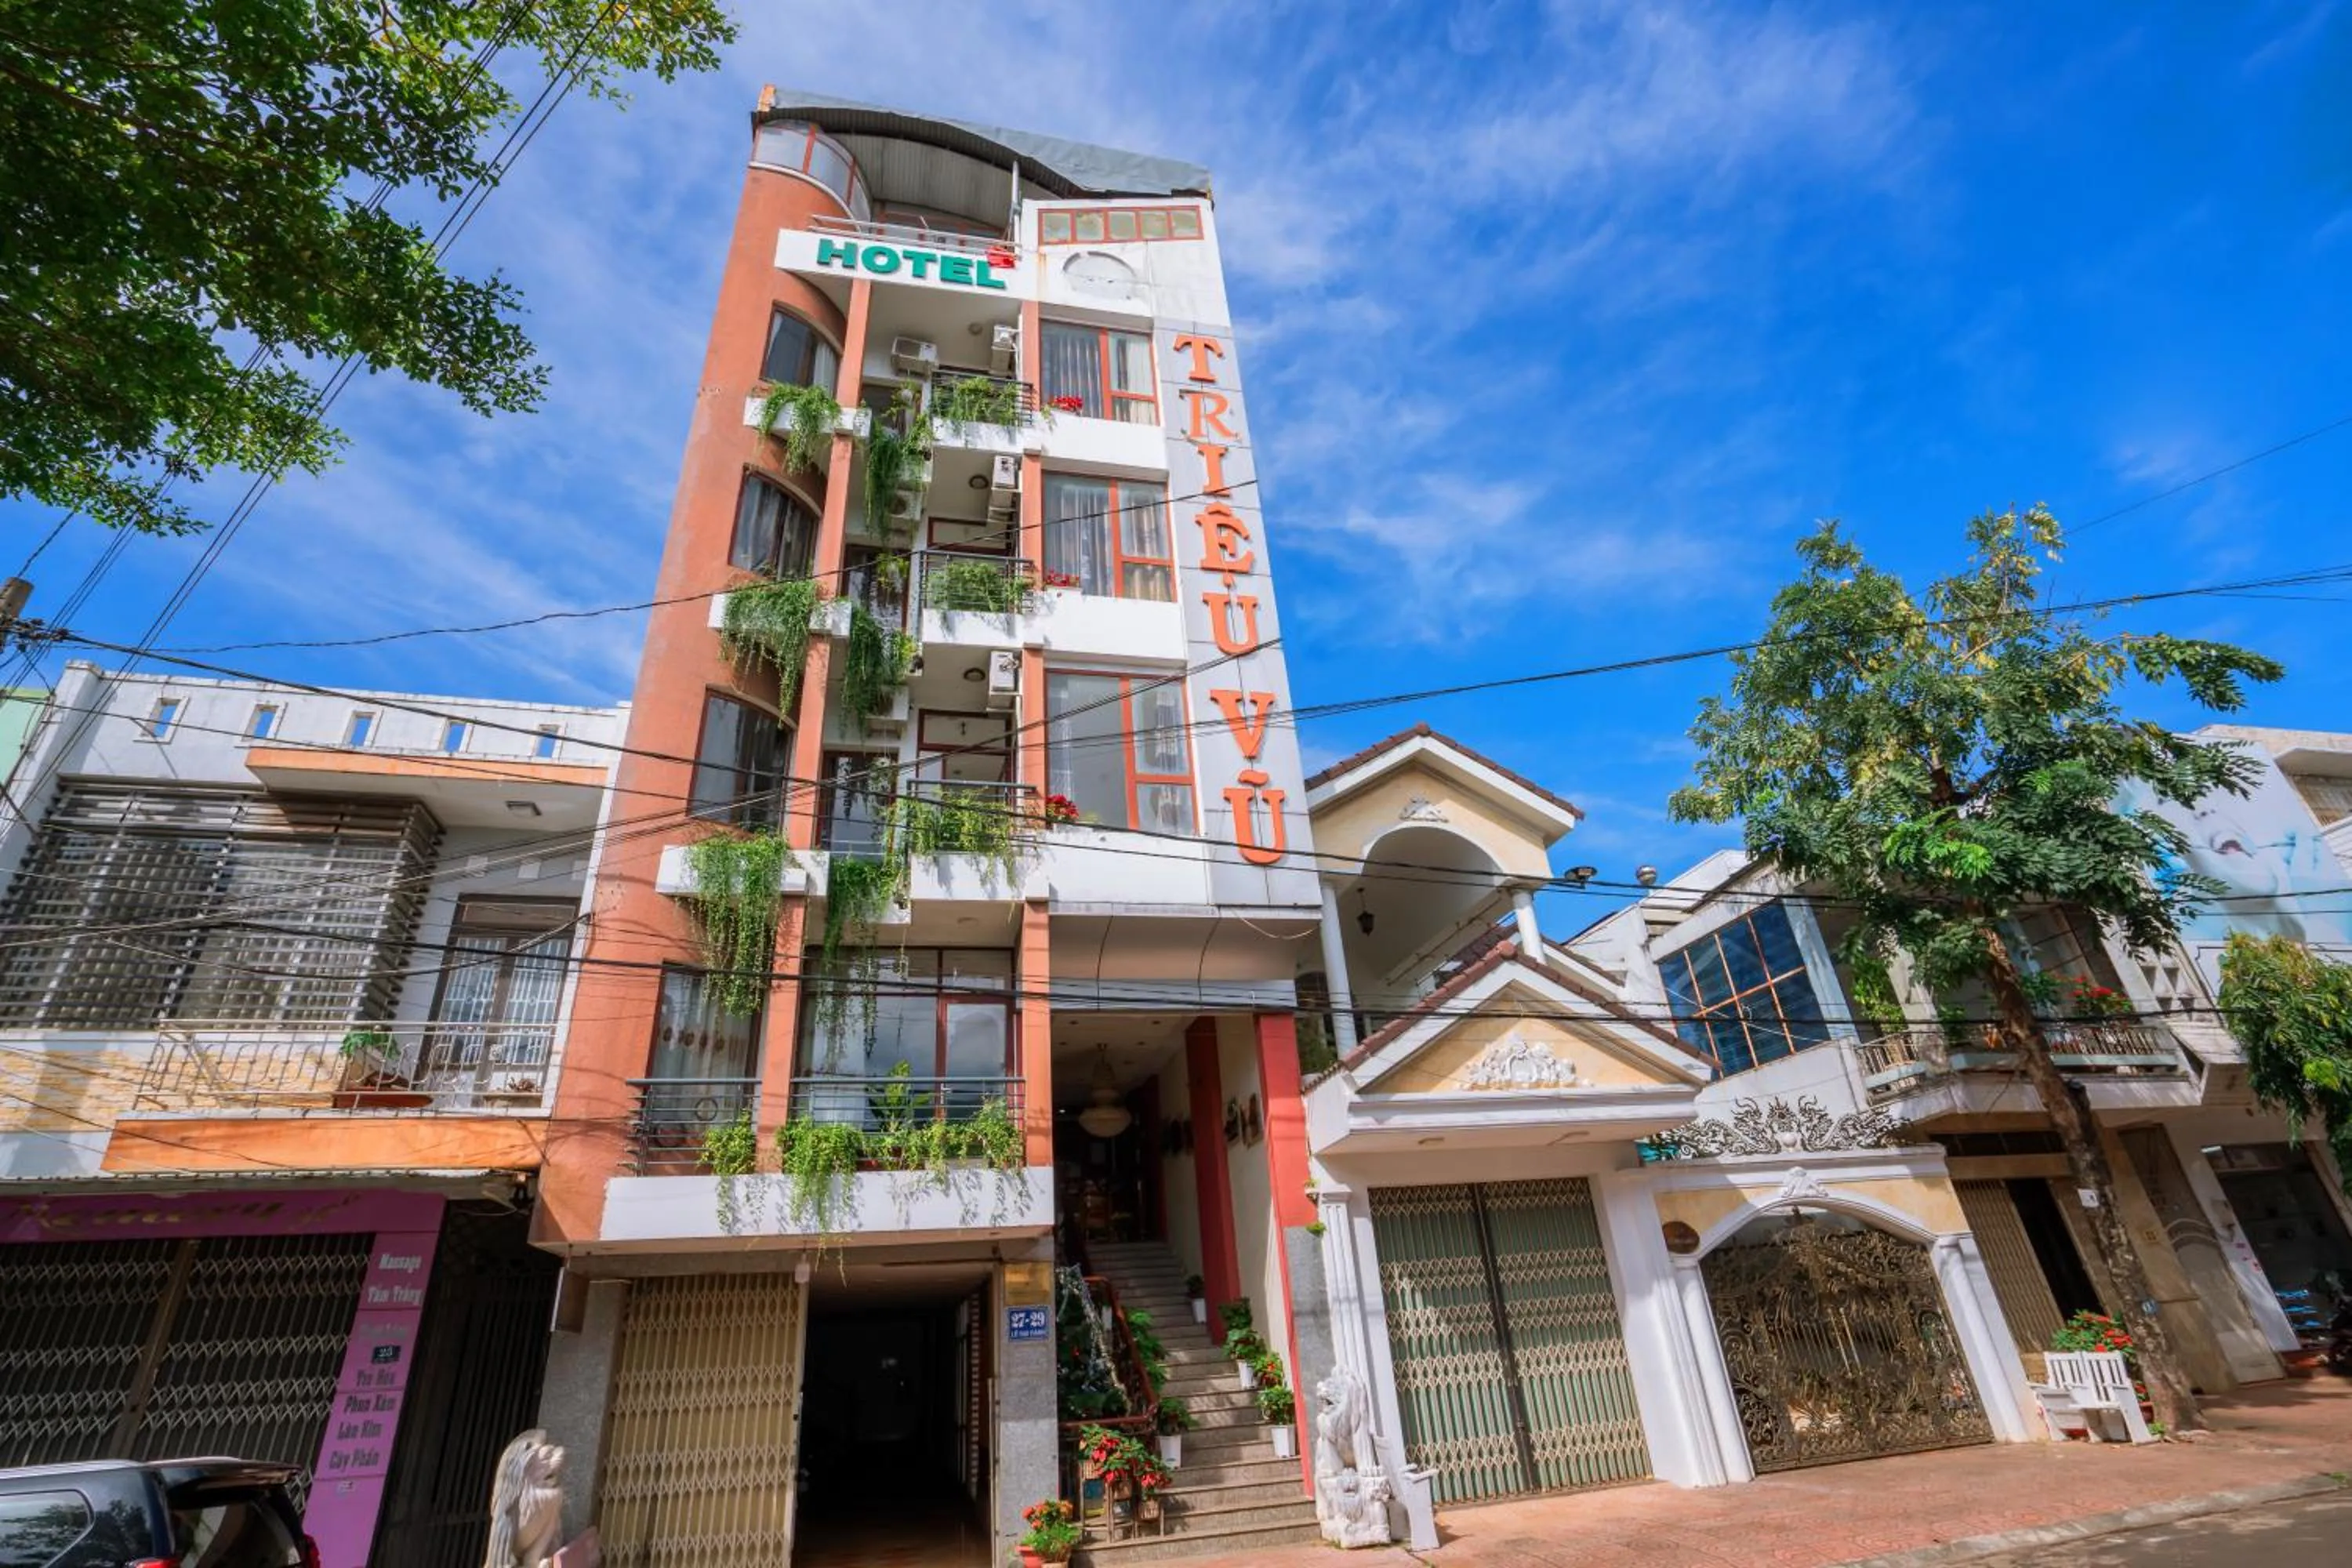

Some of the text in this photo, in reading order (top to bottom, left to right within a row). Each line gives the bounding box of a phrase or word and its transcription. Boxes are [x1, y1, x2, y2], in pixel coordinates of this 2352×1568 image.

[817, 238, 1006, 290] HOTEL
[1210, 688, 1287, 866] VŨ
[379, 1254, 423, 1273] Massage
[1011, 1311, 1046, 1328] 27-29
